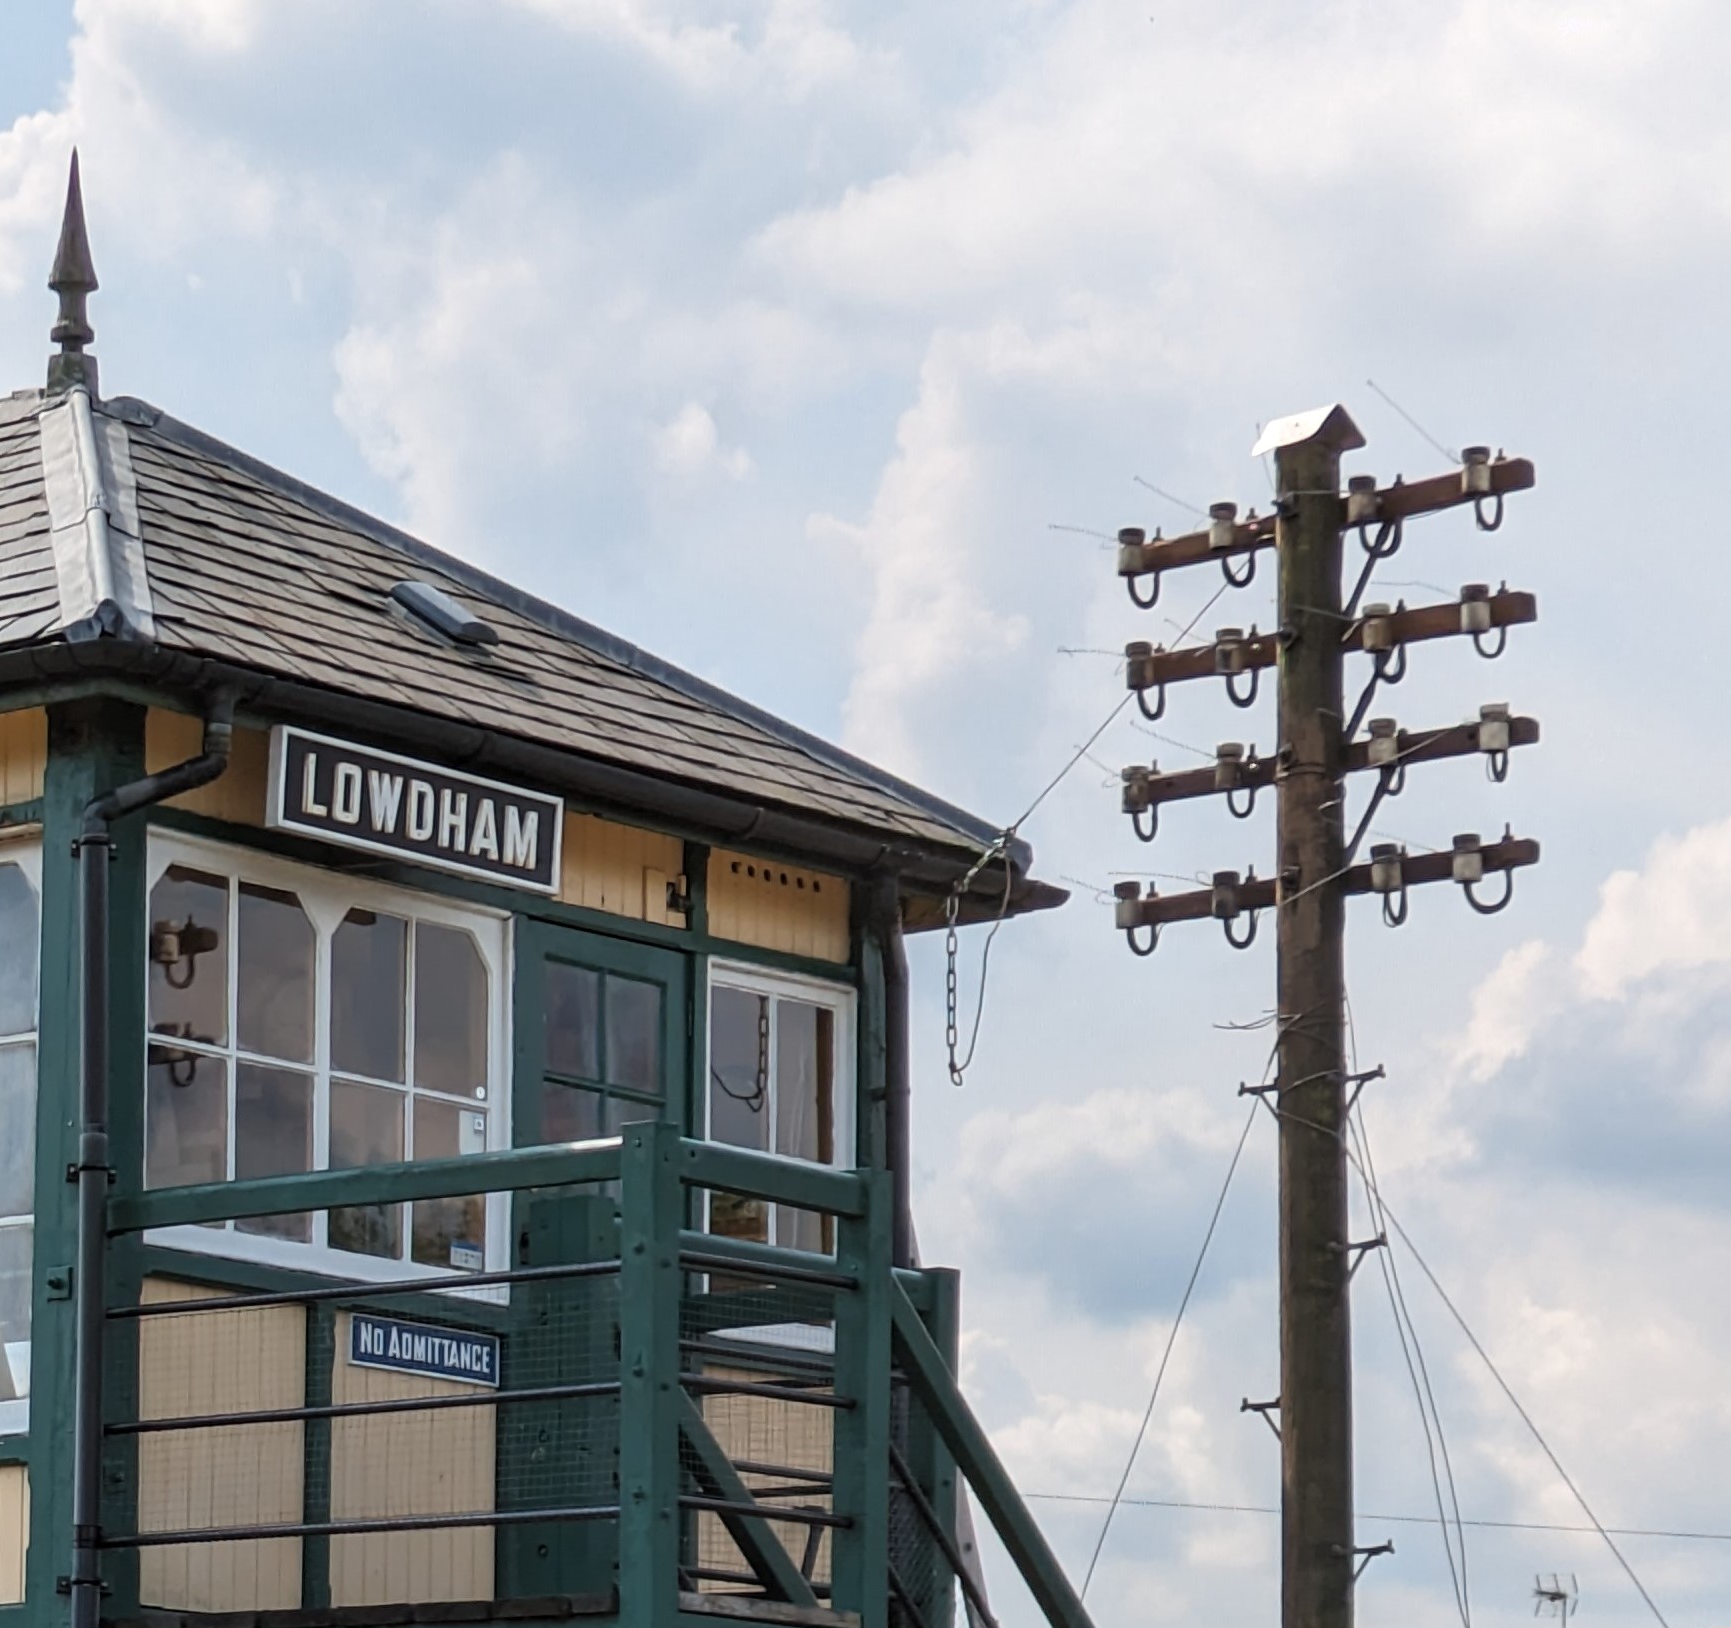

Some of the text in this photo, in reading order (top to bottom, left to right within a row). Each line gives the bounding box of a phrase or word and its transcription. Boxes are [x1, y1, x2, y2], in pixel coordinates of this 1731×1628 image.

[302, 752, 539, 871] LOWDHAM
[360, 1322, 491, 1374] NO ADMITTANCE
